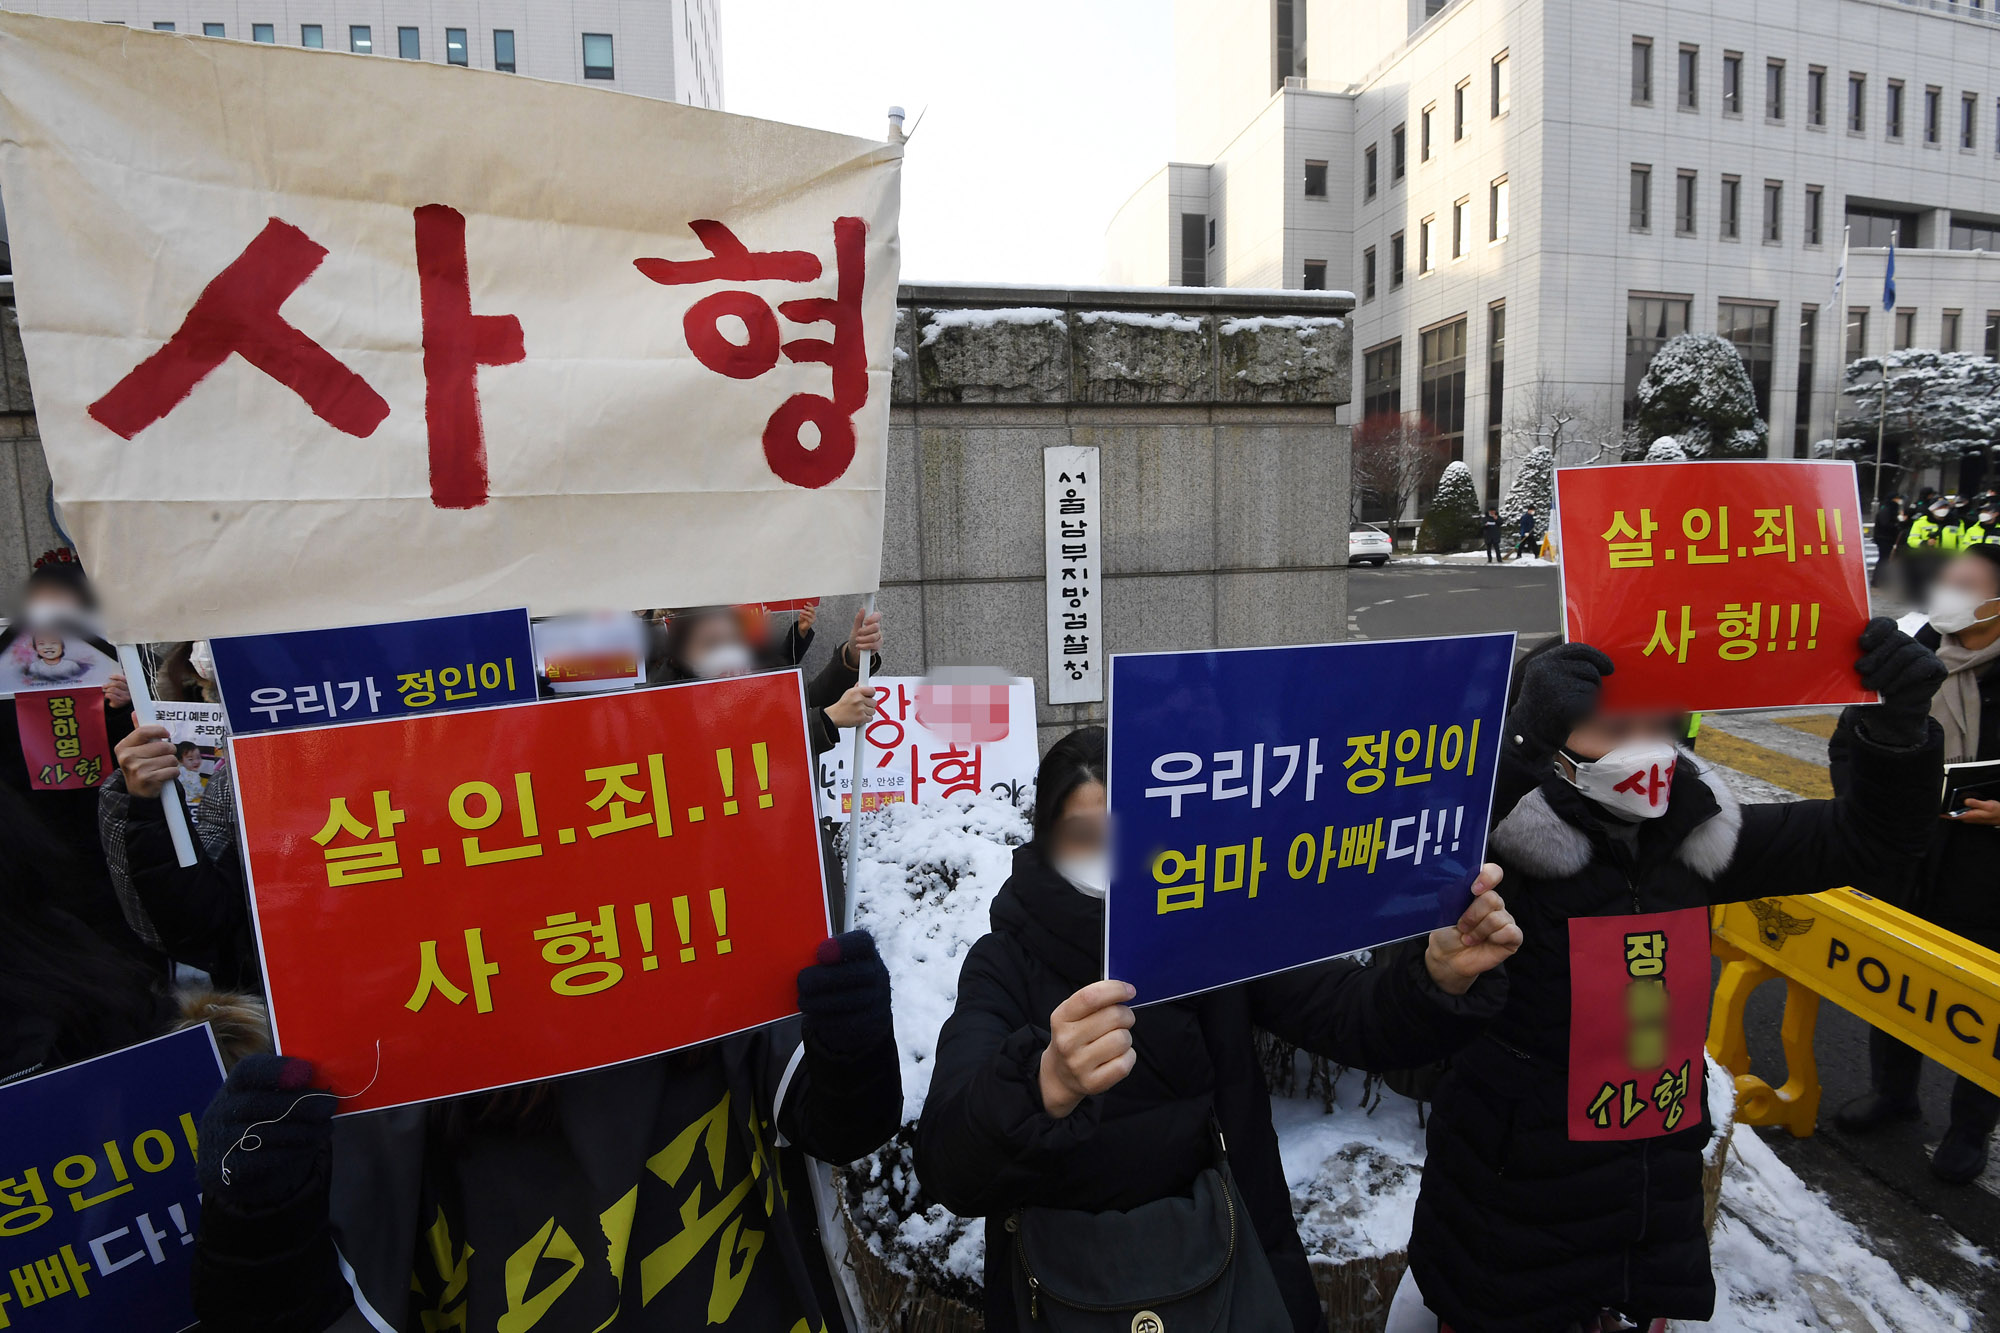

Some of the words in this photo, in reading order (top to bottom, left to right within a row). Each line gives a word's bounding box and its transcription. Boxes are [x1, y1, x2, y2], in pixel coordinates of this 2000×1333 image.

[1601, 505, 1847, 569] 살.인.죄.!!
[1059, 472, 1090, 680] 서울남부지방검찰청
[188, 711, 209, 722] 예쁜
[250, 676, 382, 724] 우리가
[397, 658, 516, 707] 정인이
[48, 697, 81, 758] 장하영
[876, 776, 905, 787] 안성은
[1145, 738, 1323, 818] 우리가
[1342, 719, 1481, 794] 정인이
[1612, 762, 1678, 807] 사
[311, 742, 774, 888] 살.인.죄.!!
[842, 797, 876, 810] 살죄
[1151, 843, 1267, 915] 엄마
[1287, 805, 1465, 884] 아빠다!!
[1588, 1059, 1690, 1131] 사형
